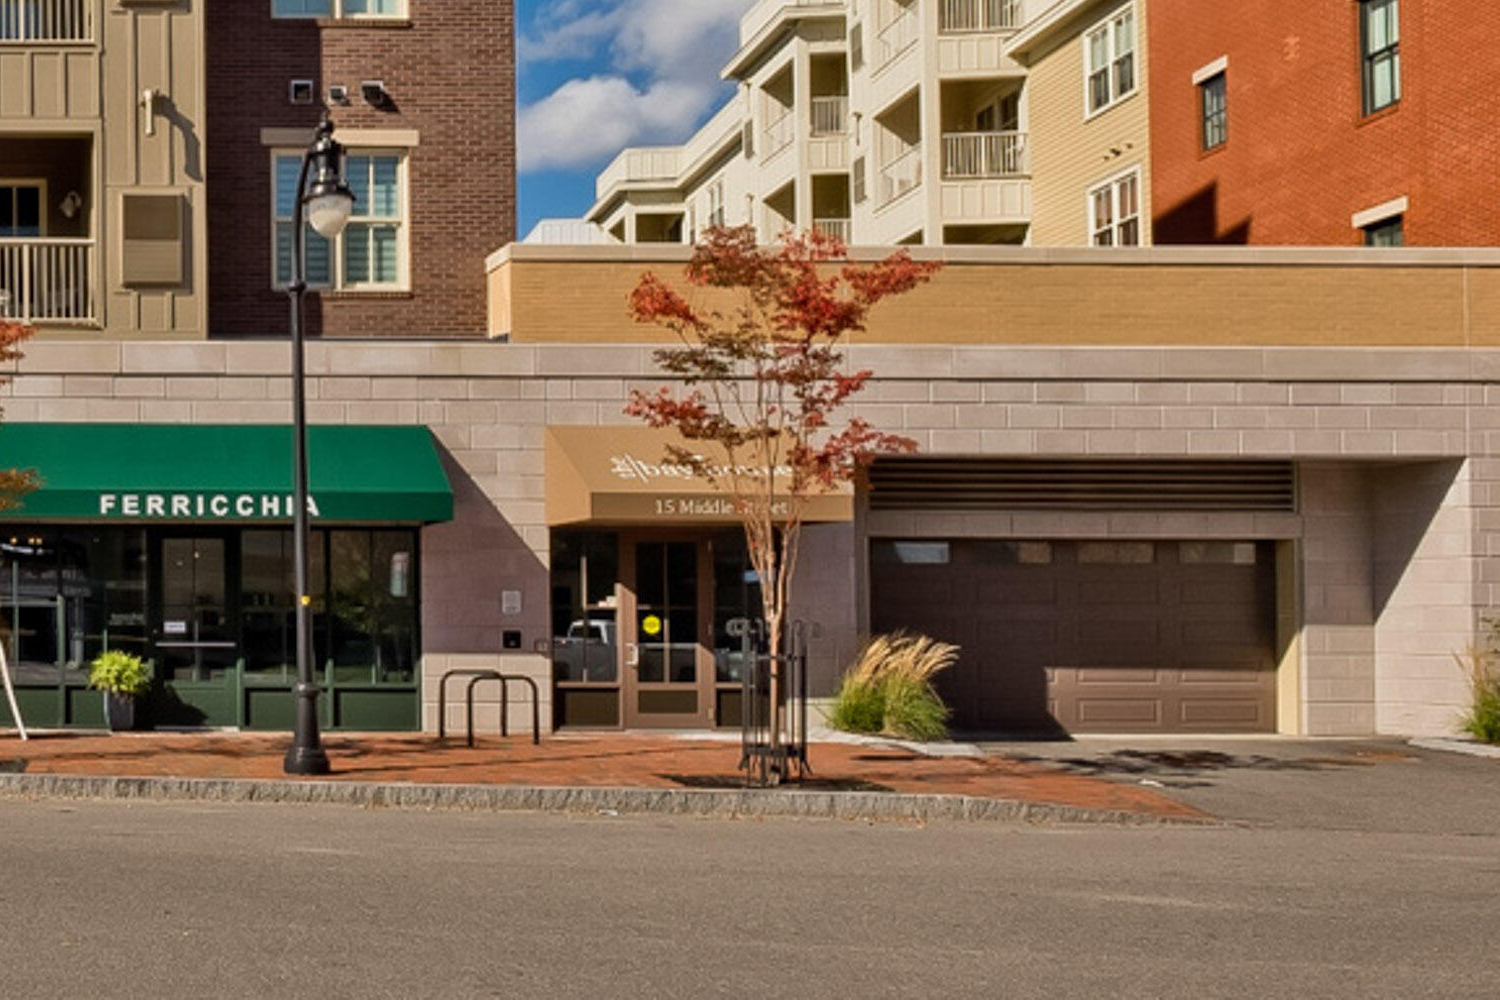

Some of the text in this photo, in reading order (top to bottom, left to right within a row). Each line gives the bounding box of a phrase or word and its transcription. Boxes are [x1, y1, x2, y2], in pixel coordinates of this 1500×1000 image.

[100, 494, 320, 516] FERRICCHIA
[656, 499, 674, 514] 15
[679, 499, 734, 514] Middle
